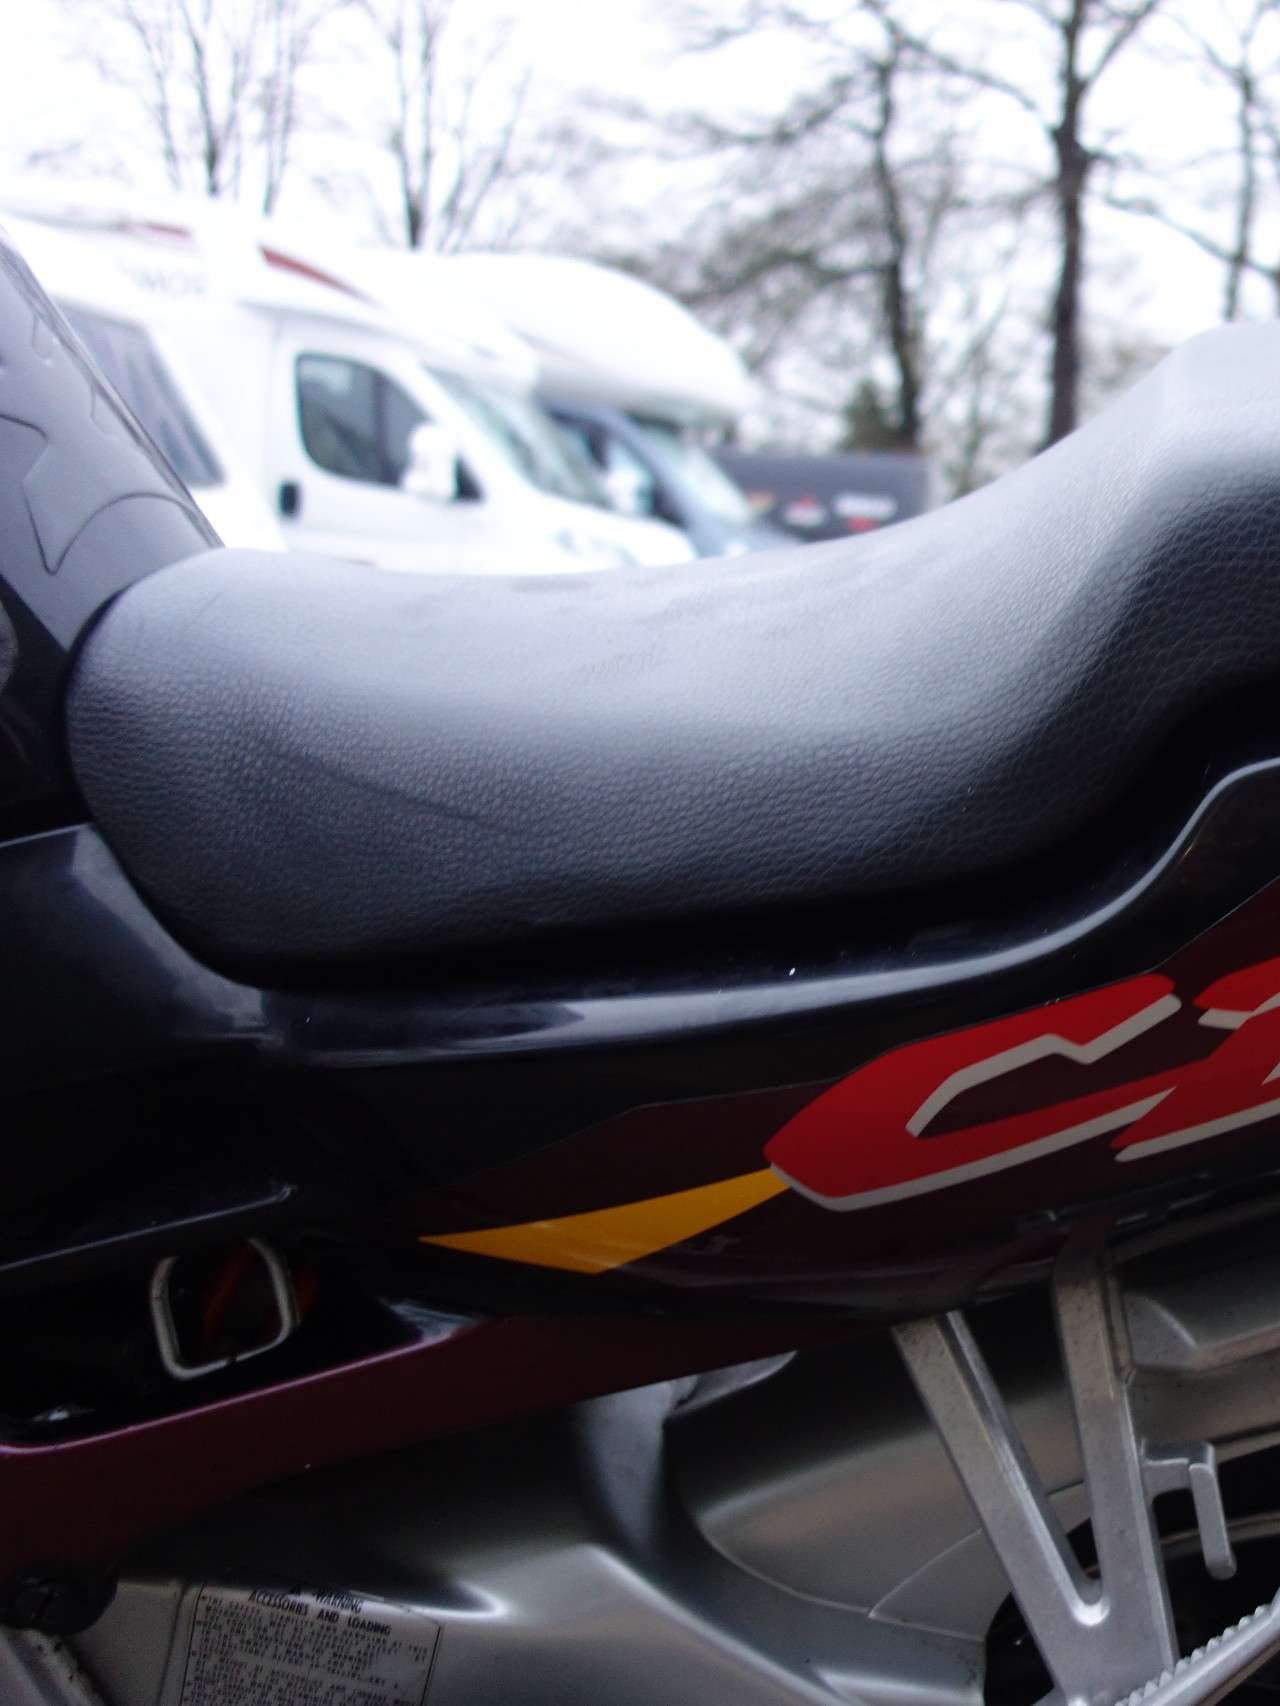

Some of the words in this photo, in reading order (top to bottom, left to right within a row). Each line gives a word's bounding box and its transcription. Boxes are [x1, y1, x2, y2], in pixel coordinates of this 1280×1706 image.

[248, 1588, 309, 1616] ACCESSORIES
[316, 1609, 340, 1624] AND
[347, 1615, 393, 1636] LOADING
[315, 1588, 365, 1613] WARNING
